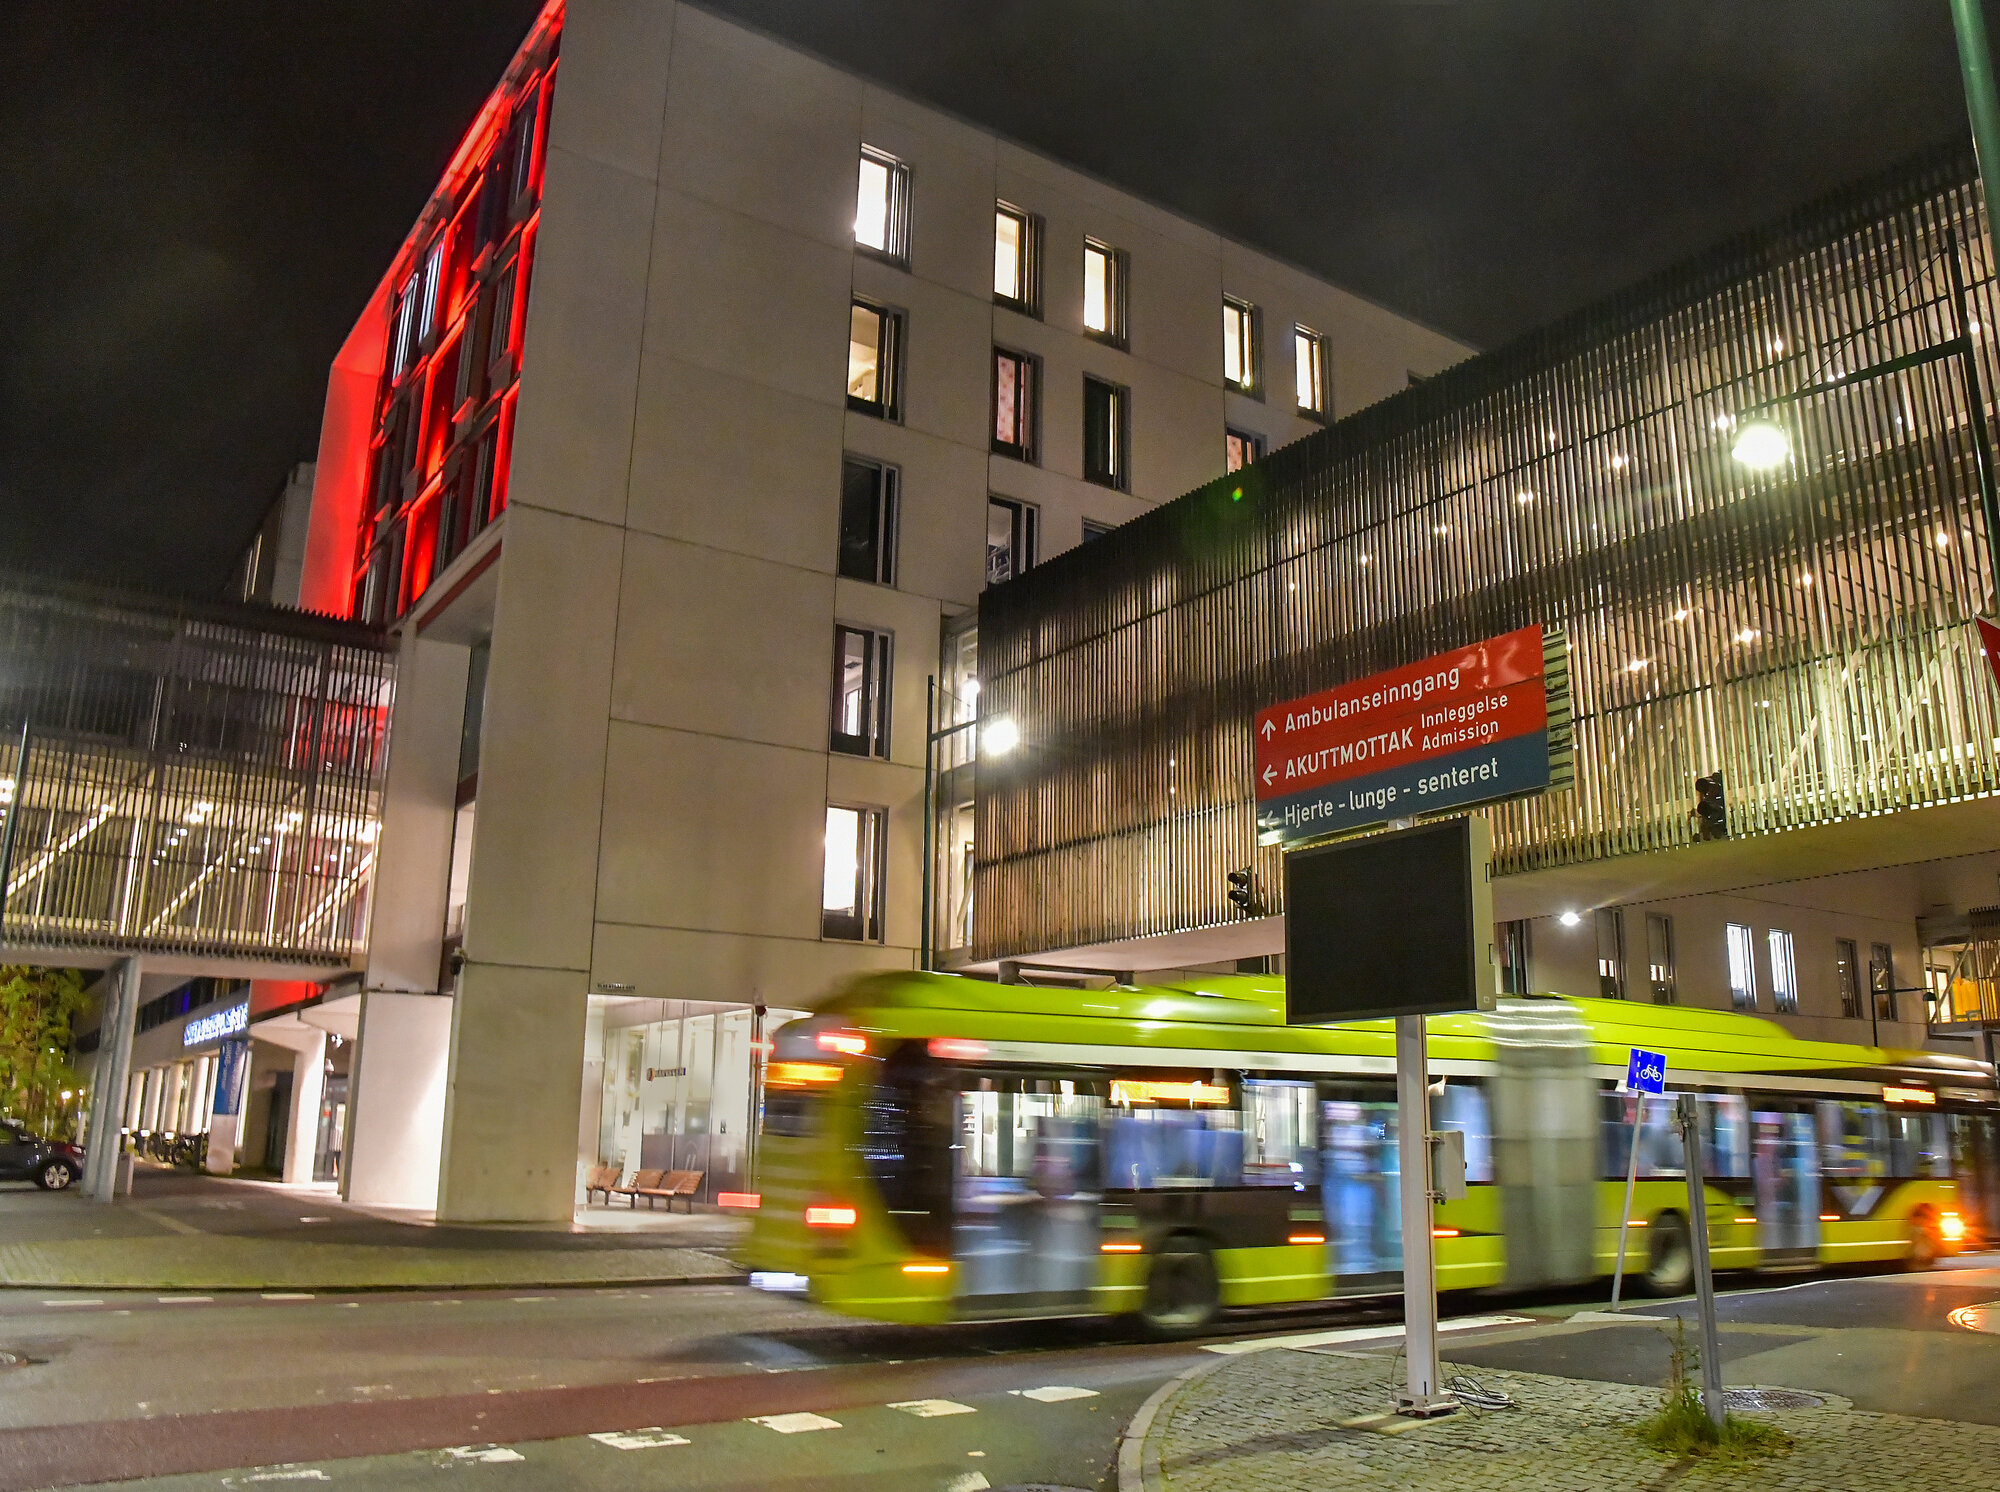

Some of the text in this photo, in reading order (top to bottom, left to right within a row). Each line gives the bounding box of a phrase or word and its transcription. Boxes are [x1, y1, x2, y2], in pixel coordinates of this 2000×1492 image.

[1285, 667, 1460, 733] Ambulanseinngang
[1421, 694, 1508, 729] Innleggelse
[1285, 726, 1414, 779] AKUTTMOTTAK
[1422, 720, 1499, 751] Admission
[1284, 799, 1333, 829] Hjerte
[1349, 785, 1397, 811] lunge
[1417, 757, 1499, 795] senteret
